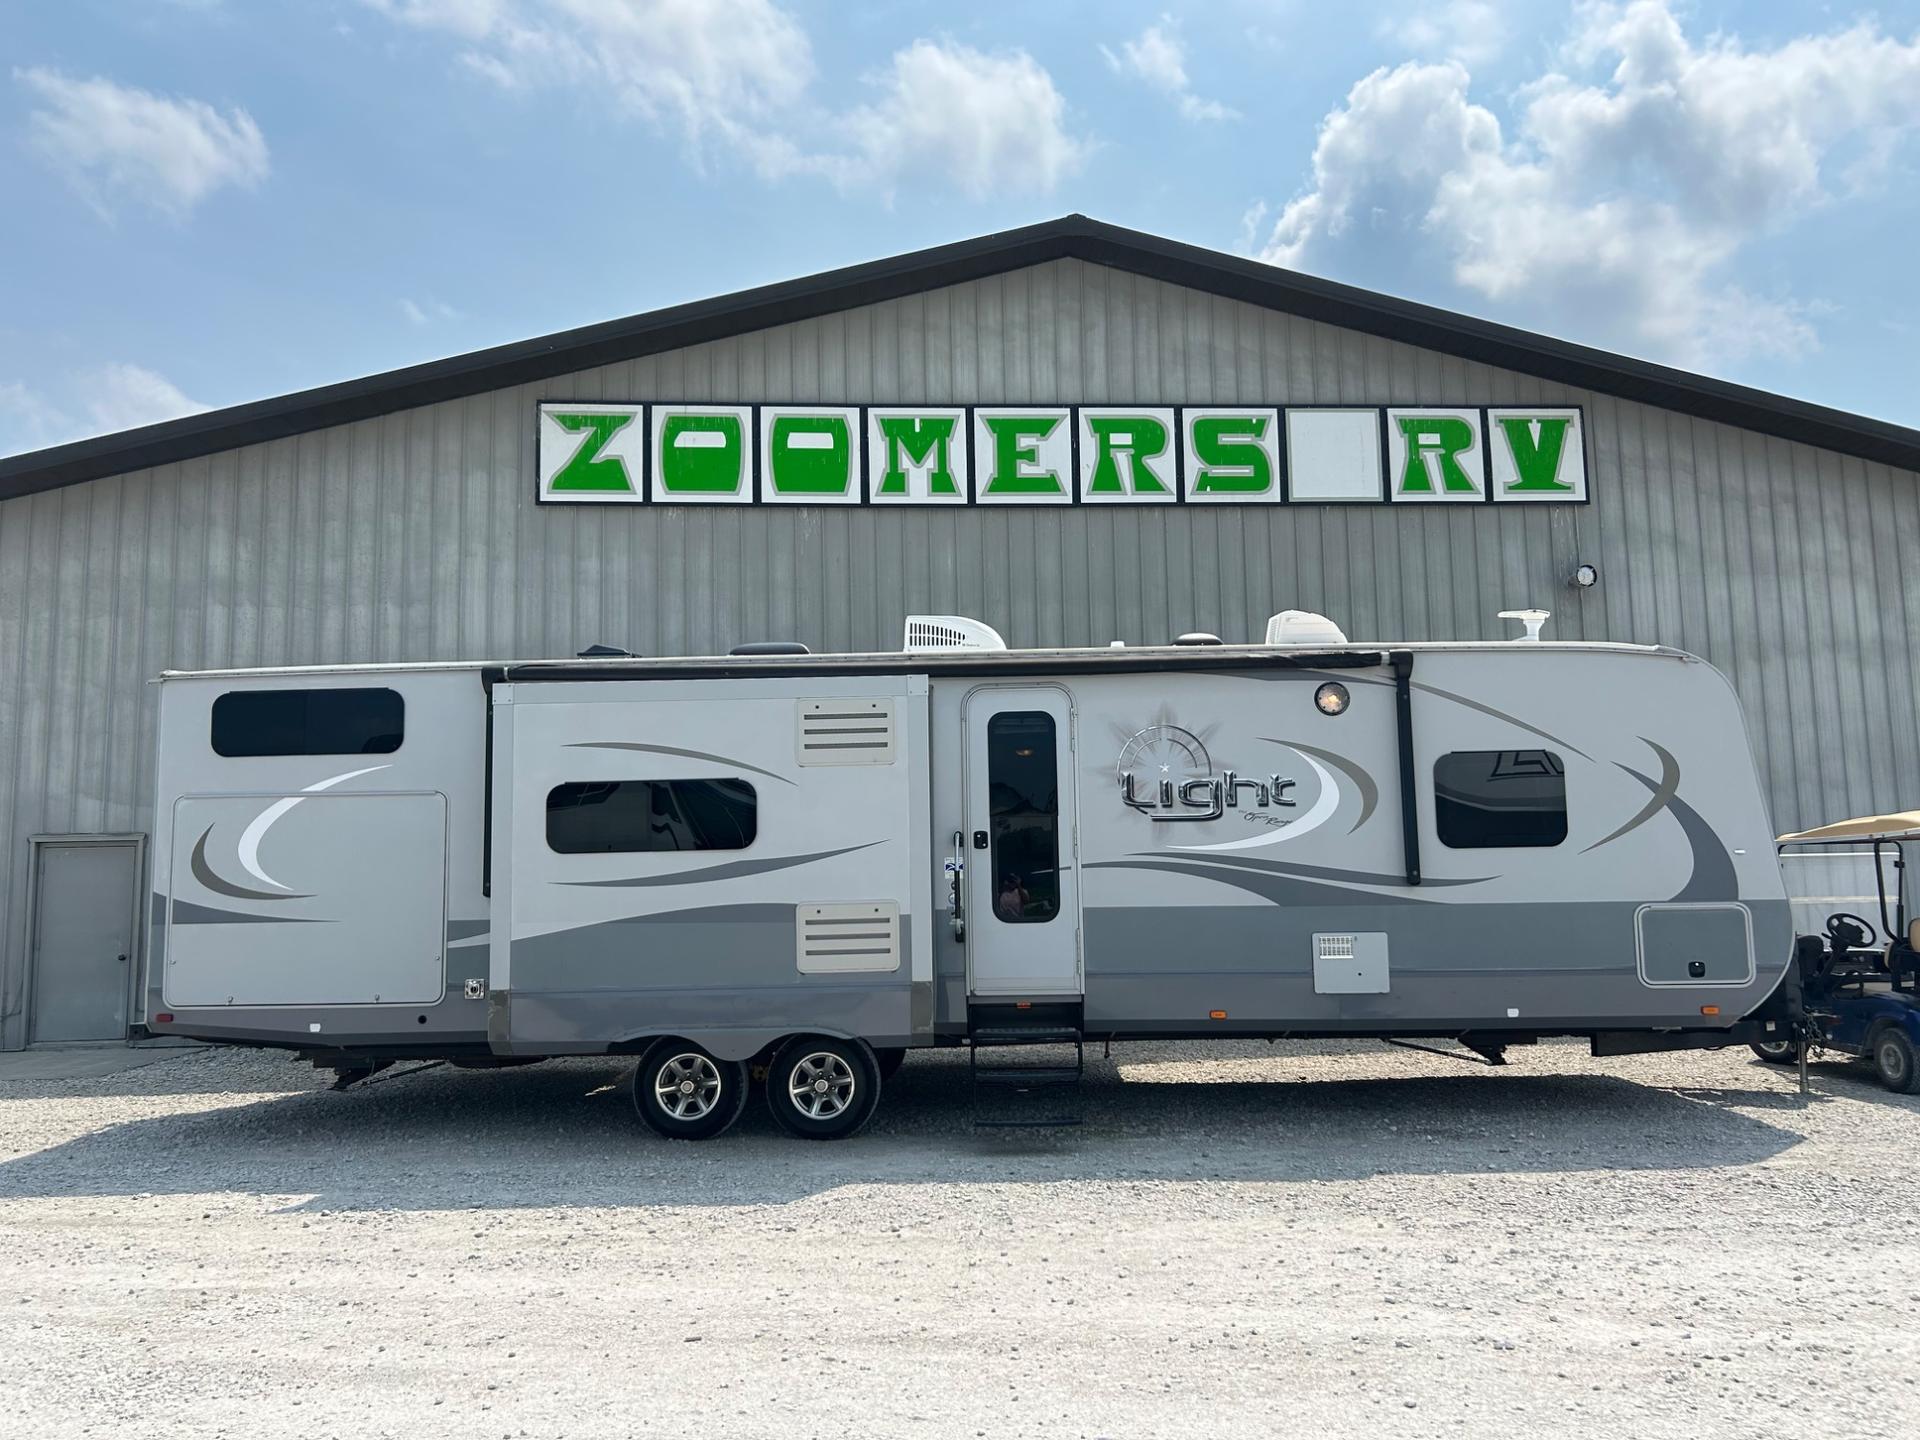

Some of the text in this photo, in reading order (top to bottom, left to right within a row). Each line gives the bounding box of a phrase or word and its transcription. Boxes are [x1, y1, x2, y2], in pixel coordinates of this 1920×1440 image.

[543, 412, 1576, 495] ZOOMERS RV
[1119, 768, 1297, 822] Light
